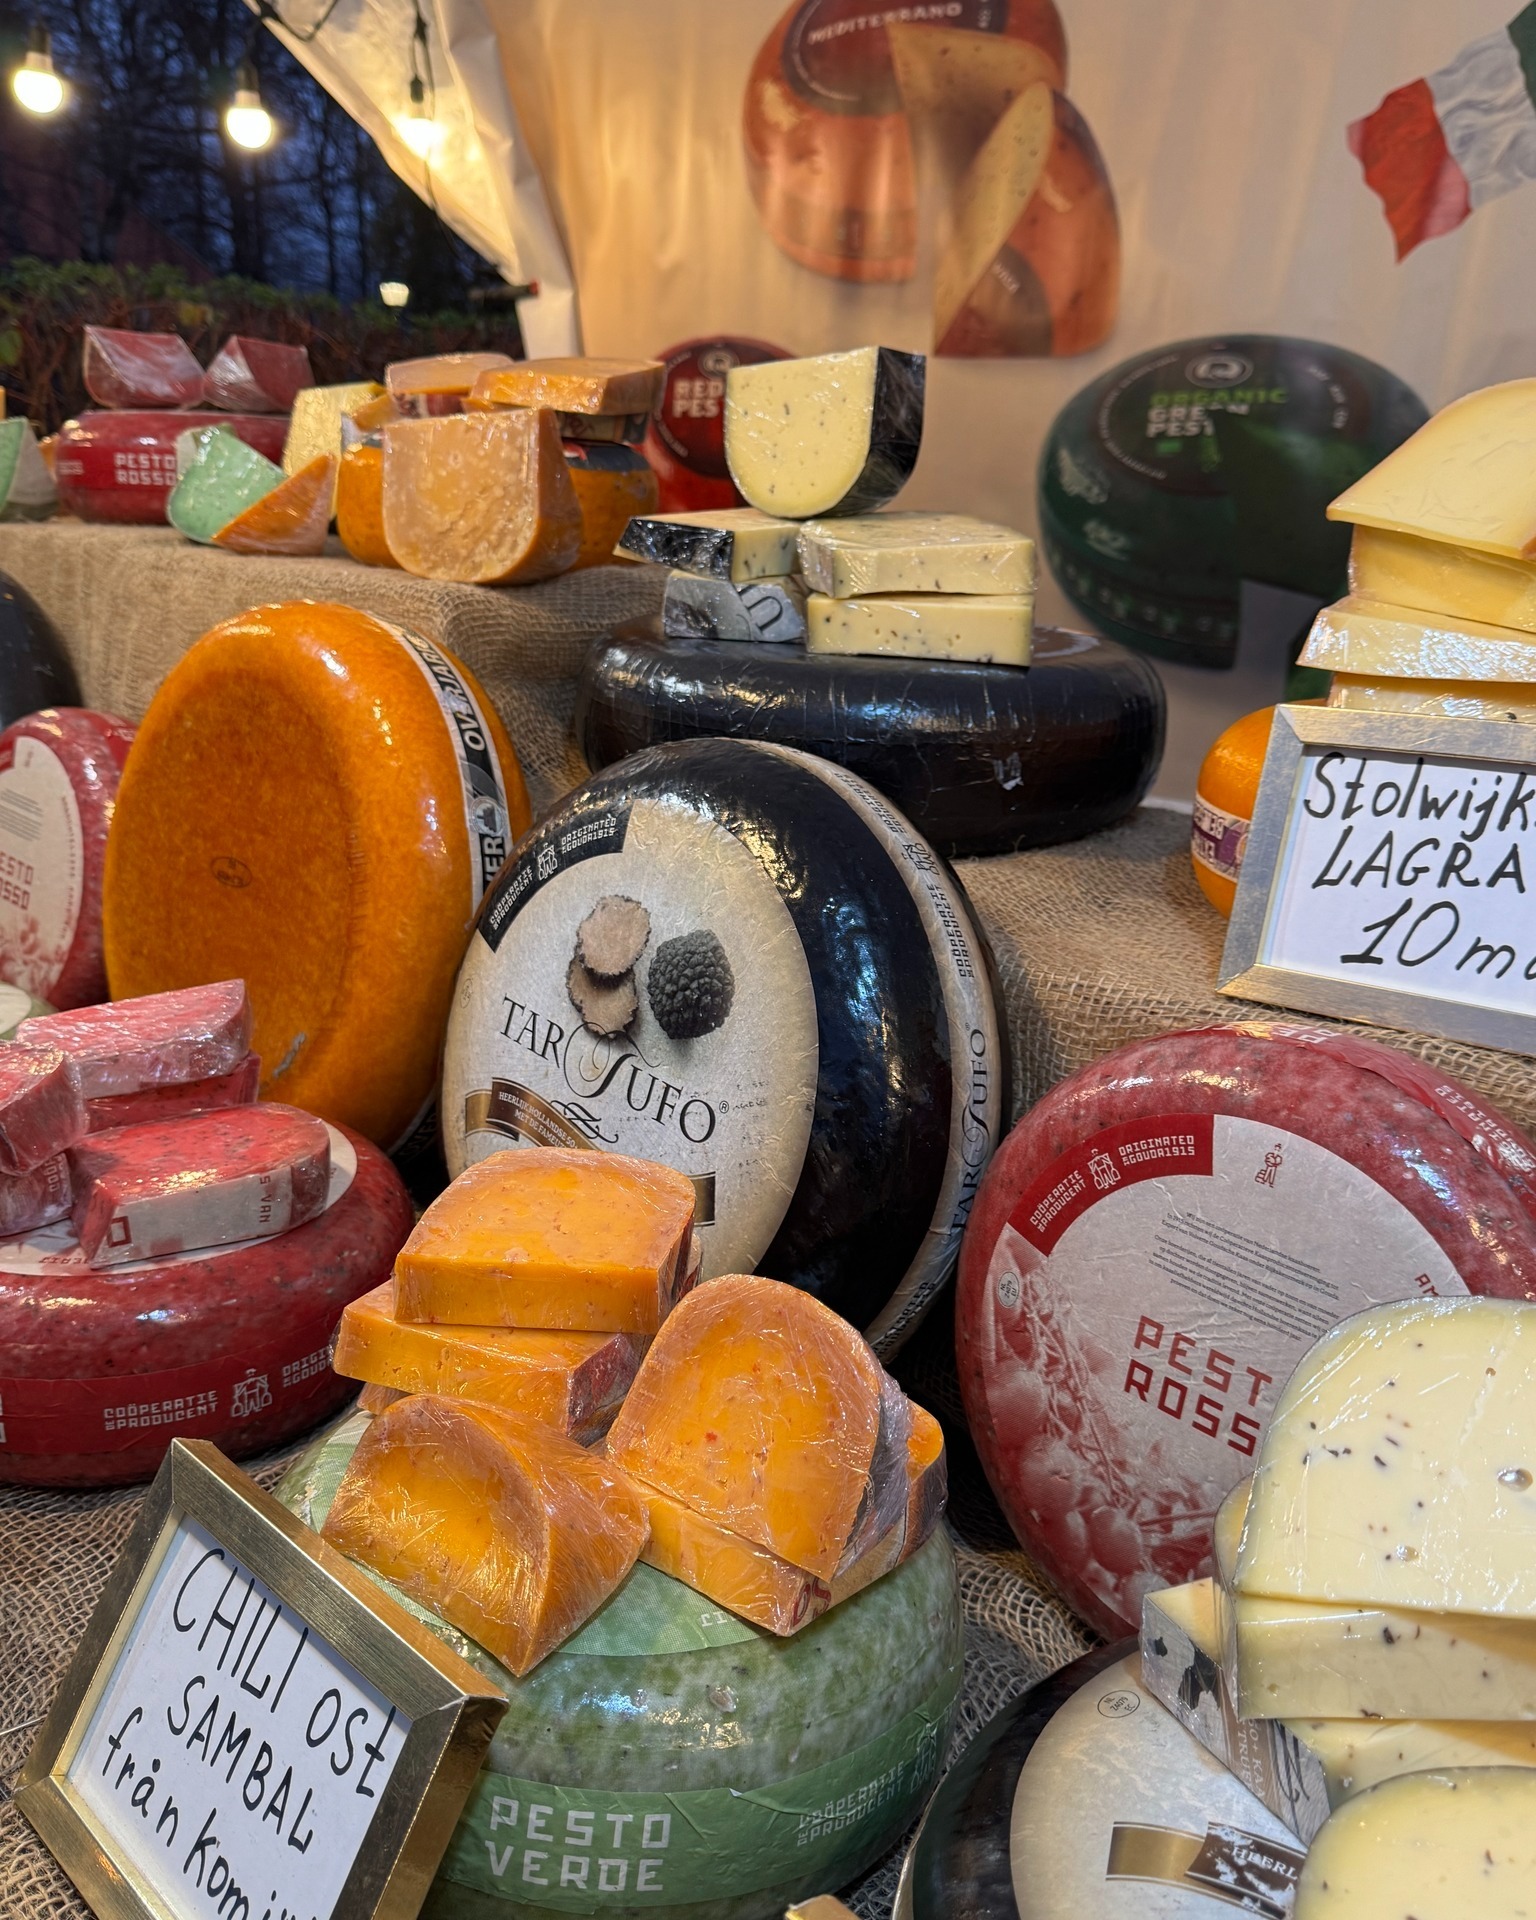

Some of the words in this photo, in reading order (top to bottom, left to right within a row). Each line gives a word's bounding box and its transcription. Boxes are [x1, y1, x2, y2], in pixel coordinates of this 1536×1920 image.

[674, 380, 723, 400] RED
[1149, 387, 1289, 406] ORGANIC
[114, 452, 176, 468] PESTO
[116, 469, 176, 486] ROSSO
[561, 817, 618, 846] ORIGINATED
[1341, 898, 1460, 967] 10
[499, 1091, 529, 1110] HEERLIJK
[528, 1105, 567, 1141] HOLLANDSE
[514, 1108, 529, 1124] MET
[529, 1118, 539, 1131] DE
[1118, 1135, 1195, 1156] ORIGINATED
[260, 1194, 271, 1224] VAN
[1029, 1169, 1083, 1226] COÖPERATIE
[1041, 1178, 1087, 1228] PRODUCENT
[1134, 1315, 1273, 1407] PEST
[103, 1390, 218, 1420] COÖPERATIE
[116, 1402, 218, 1431] PRODUCENT
[1124, 1359, 1261, 1457] ROSS
[173, 1548, 309, 1713] CHILI
[102, 1707, 179, 1847] från
[168, 1676, 313, 1854] SAMBAL
[489, 1795, 672, 1850] PESTO
[484, 1839, 664, 1893] VERDE
